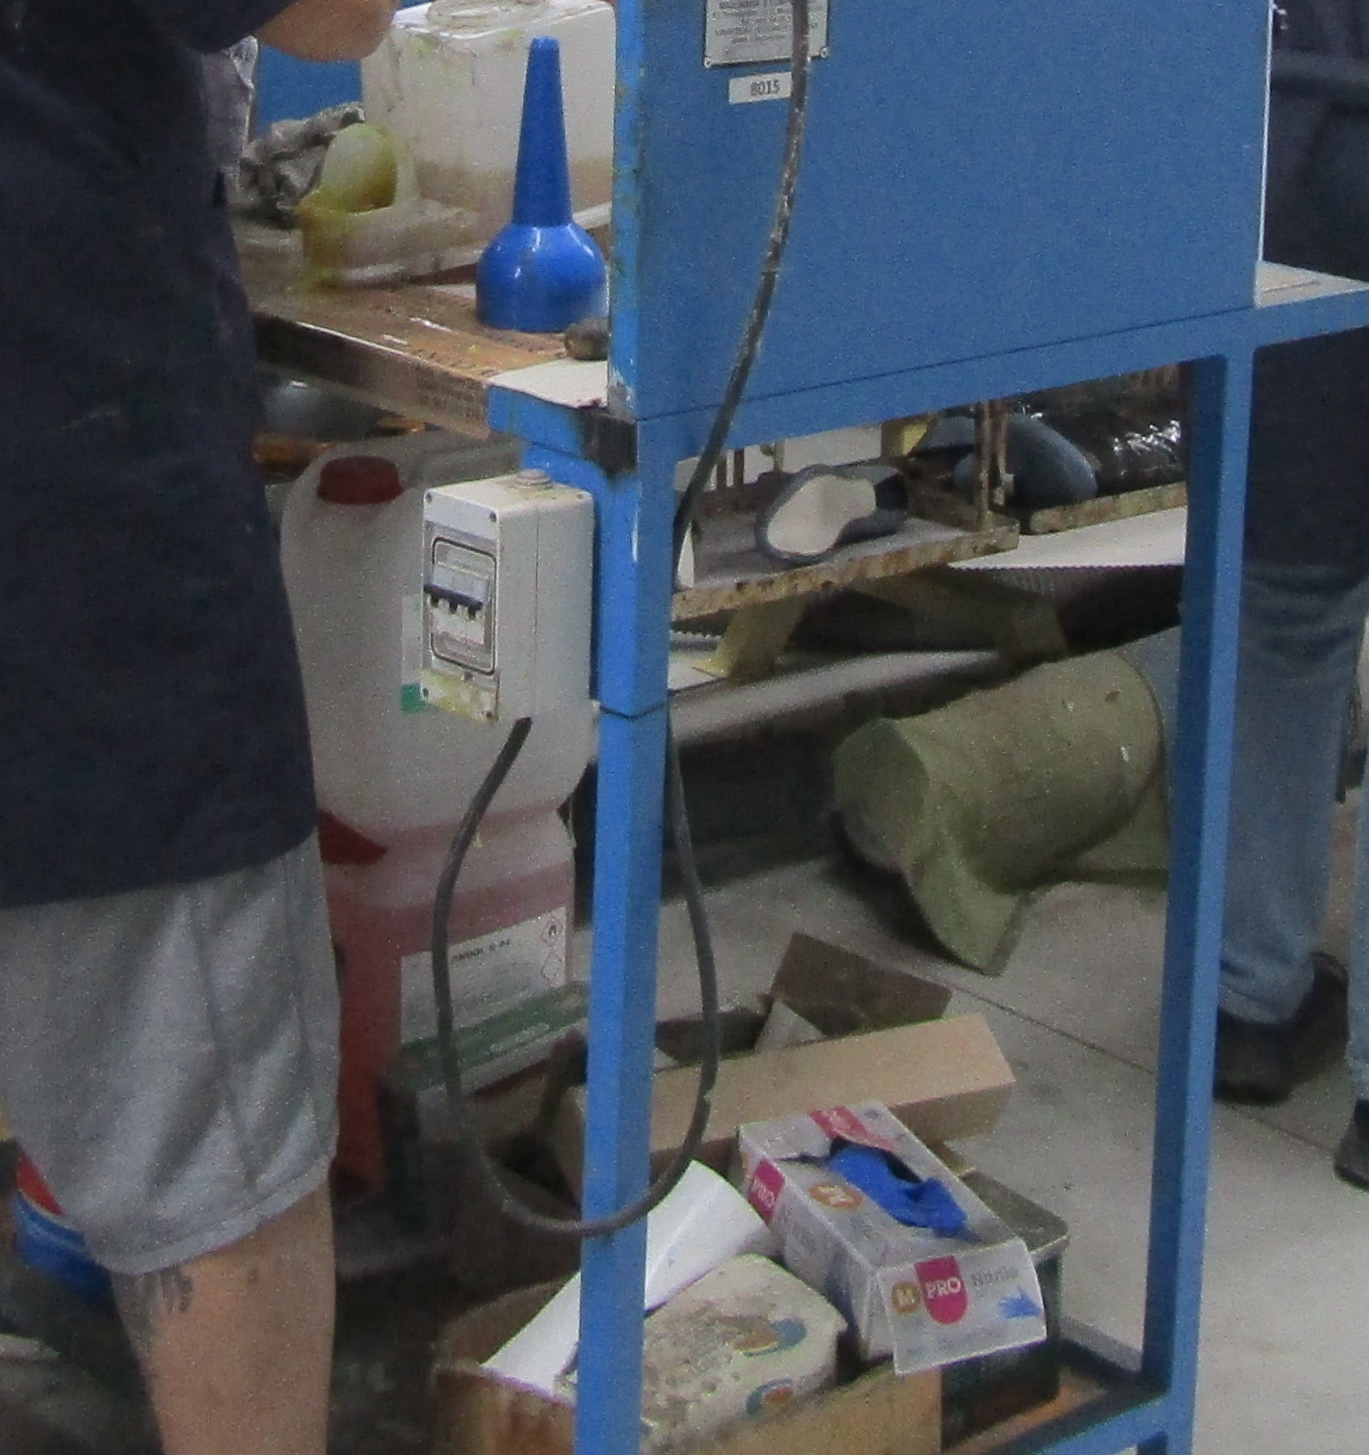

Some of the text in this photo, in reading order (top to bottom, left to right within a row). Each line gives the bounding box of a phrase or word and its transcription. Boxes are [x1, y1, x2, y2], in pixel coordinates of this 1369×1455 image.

[750, 79, 781, 96] 8015
[750, 1178, 775, 1208] PRO
[924, 1275, 962, 1300] PRO
